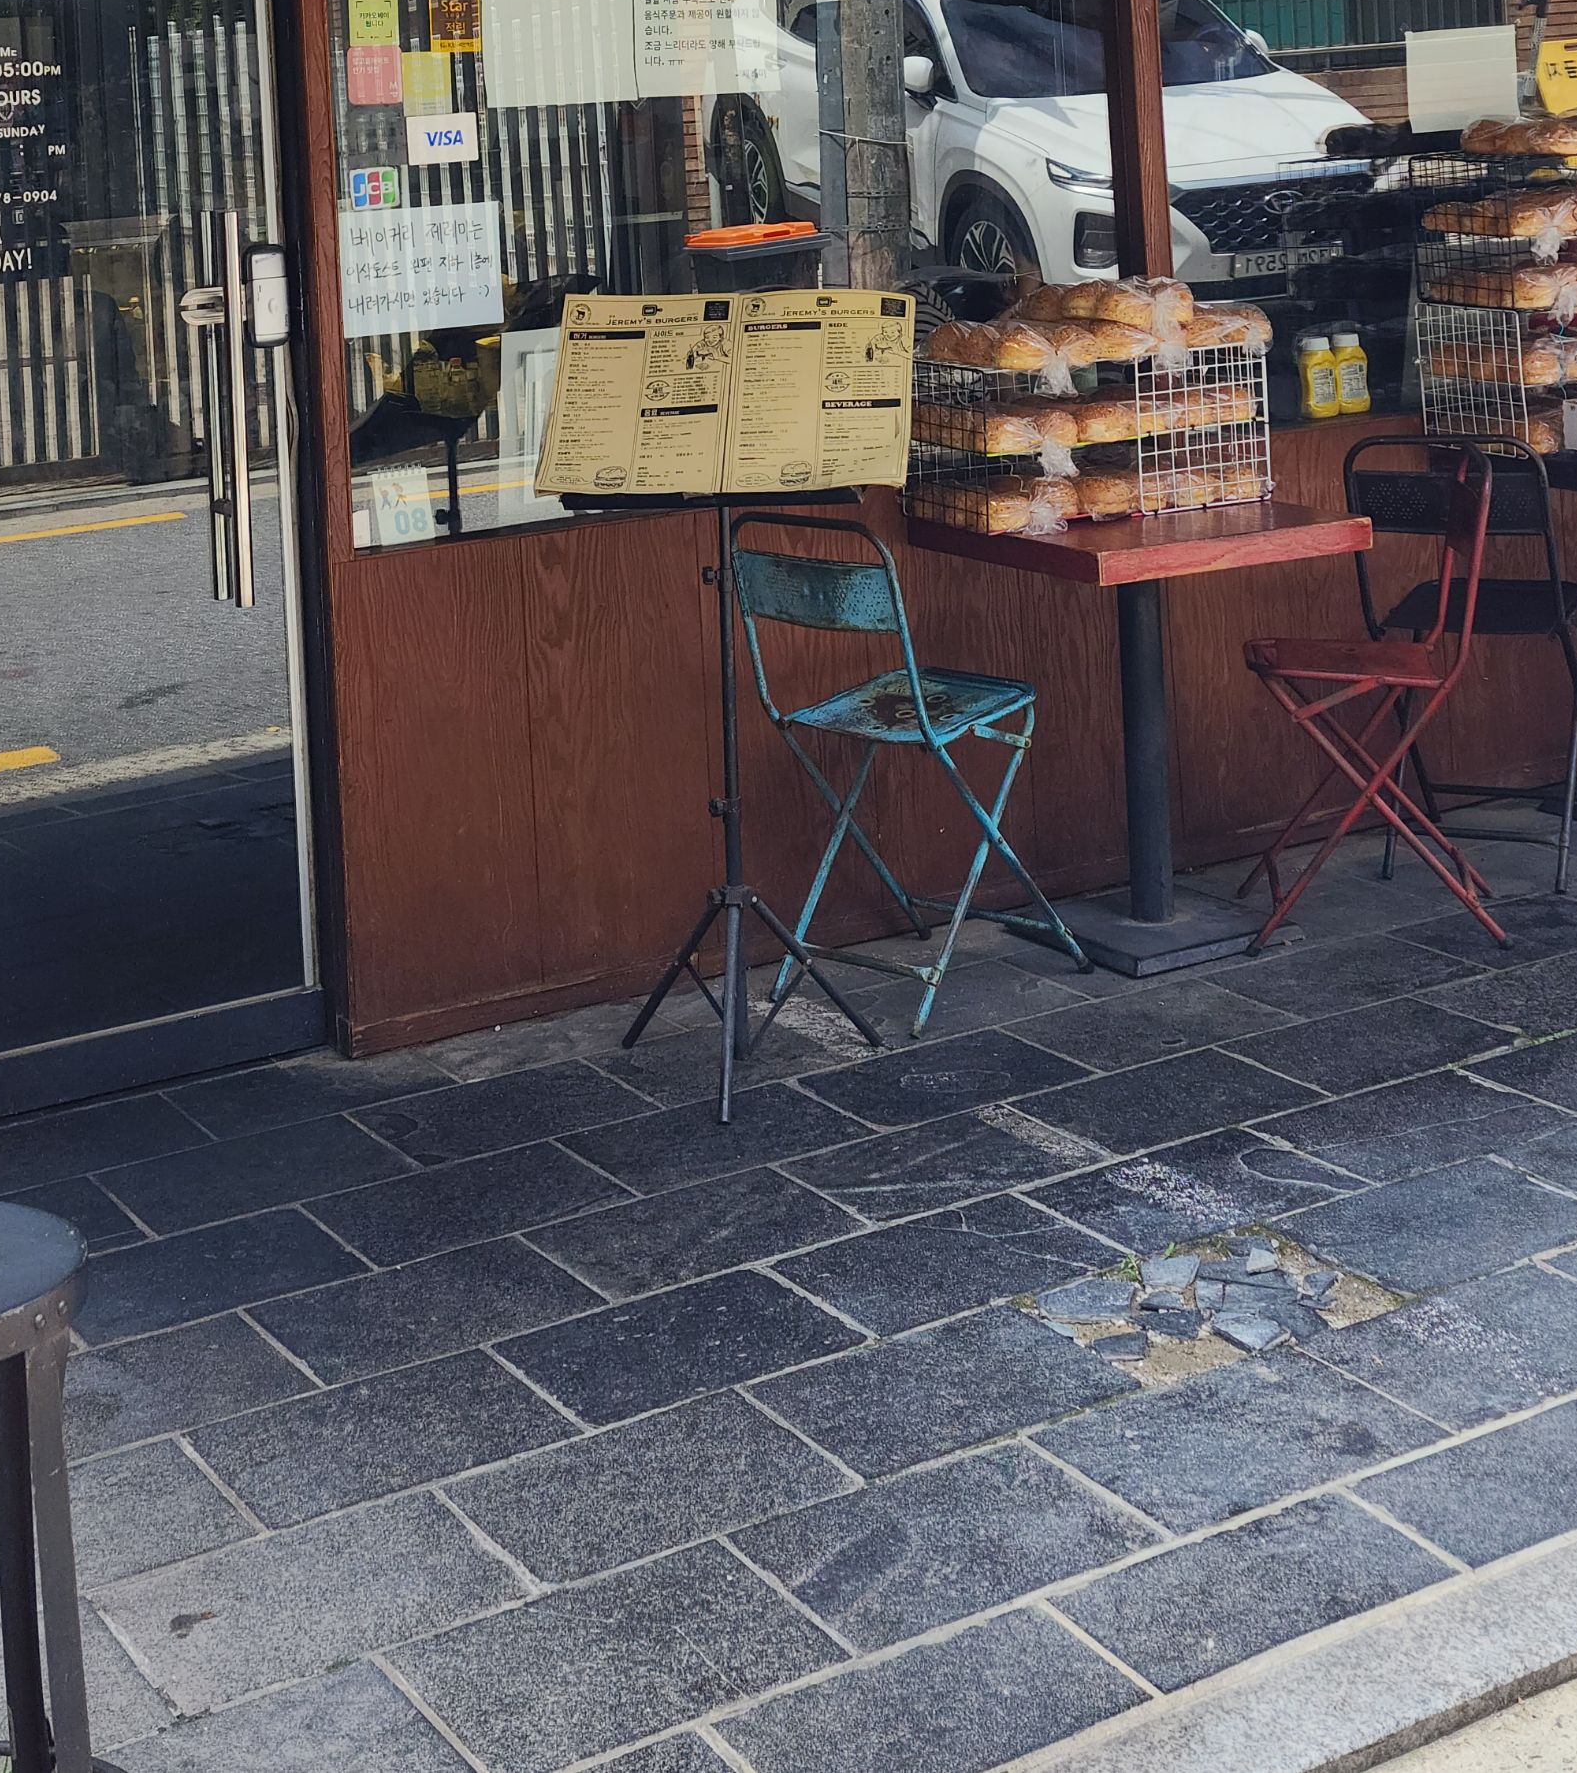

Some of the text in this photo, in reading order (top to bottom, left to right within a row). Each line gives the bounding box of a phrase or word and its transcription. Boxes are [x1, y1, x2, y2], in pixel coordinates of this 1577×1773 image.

[441, 0, 468, 12] Star
[644, 9, 685, 21] 음식주문과
[688, 8, 713, 20] 제공이
[445, 21, 466, 35] 적립
[644, 25, 673, 36] 습니다.
[644, 41, 661, 51] 조금
[665, 39, 706, 51] 느리더라도
[709, 39, 726, 49] 양해
[644, 55, 665, 66] 니다.
[424, 130, 464, 147] VISA
[48, 144, 66, 156] PM
[350, 219, 484, 257] 베이커리 제레미는
[346, 260, 402, 284] 이삭토스트
[439, 253, 465, 272] 지하
[348, 289, 415, 316] 내려가시면
[422, 286, 467, 306] 있습니다
[780, 308, 827, 317] JEREMY'S
[605, 315, 699, 326] JEREMY'S BURGERS
[653, 329, 673, 338] 사이드
[747, 323, 788, 332] BURGERS
[573, 332, 587, 340] 버거
[394, 507, 428, 535] 08
